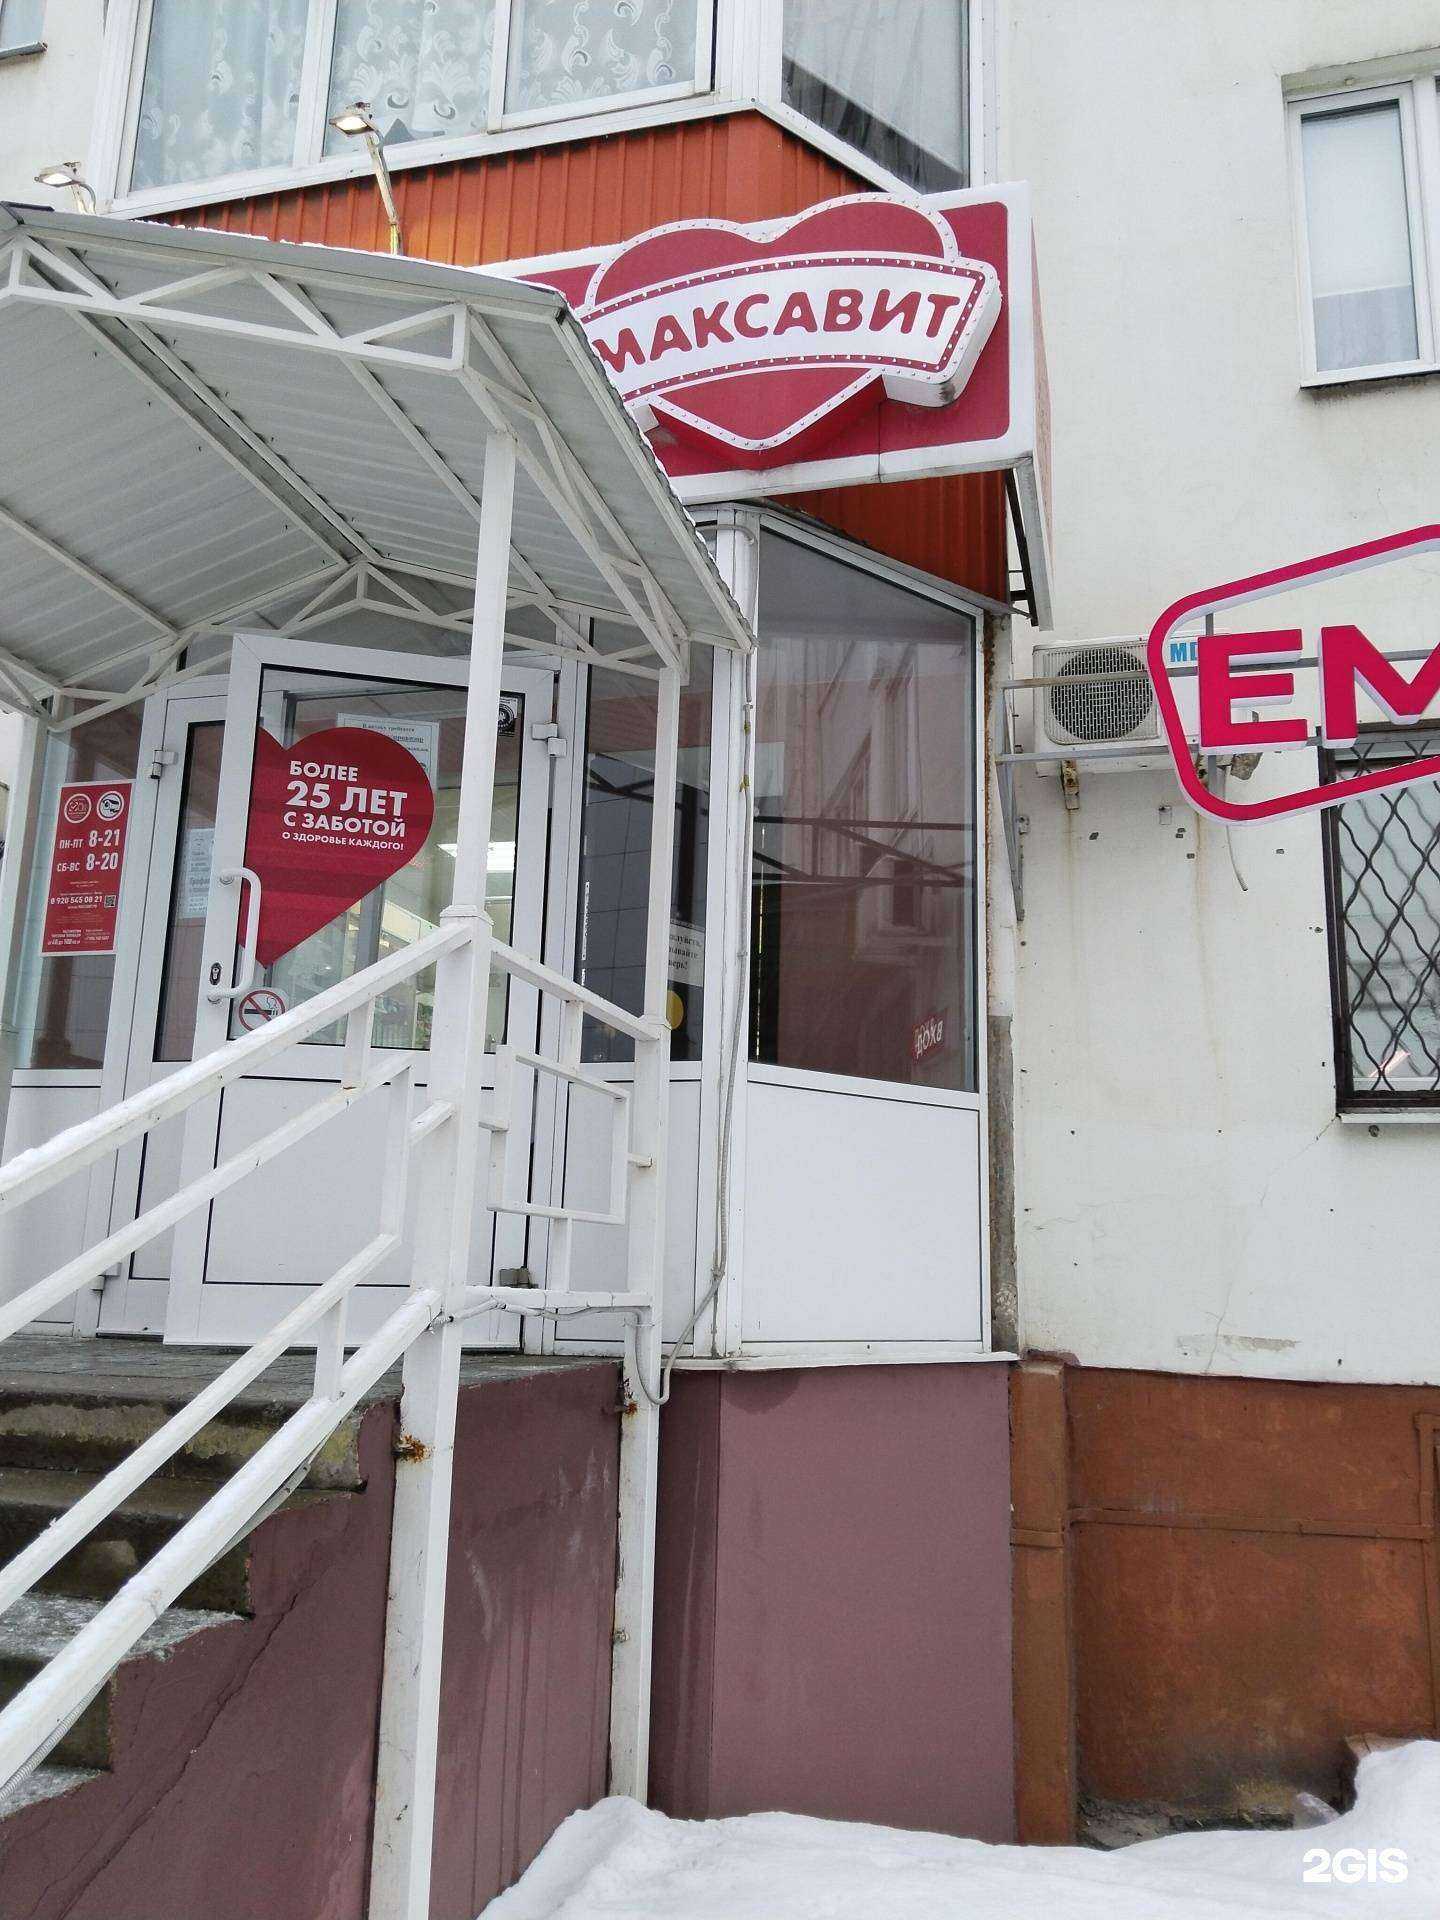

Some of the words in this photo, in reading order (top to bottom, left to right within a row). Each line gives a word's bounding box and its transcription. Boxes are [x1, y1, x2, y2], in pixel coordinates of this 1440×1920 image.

[591, 288, 961, 373] МАКСАВИТ
[289, 760, 359, 782] БОЛЕЕ
[285, 780, 331, 809] 25
[339, 786, 408, 817] ЛЕТ
[283, 811, 297, 826] С
[301, 813, 406, 837] ЗАБОТОЙ
[59, 838, 84, 849] ПН-ПТ
[88, 829, 121, 848] 8-21
[282, 831, 291, 840] О
[292, 832, 347, 845] ЗДОРОВЬЕ
[348, 837, 404, 850] КАЖДОГО!
[57, 862, 81, 872] СБ-ВС
[86, 852, 119, 871] 8-20
